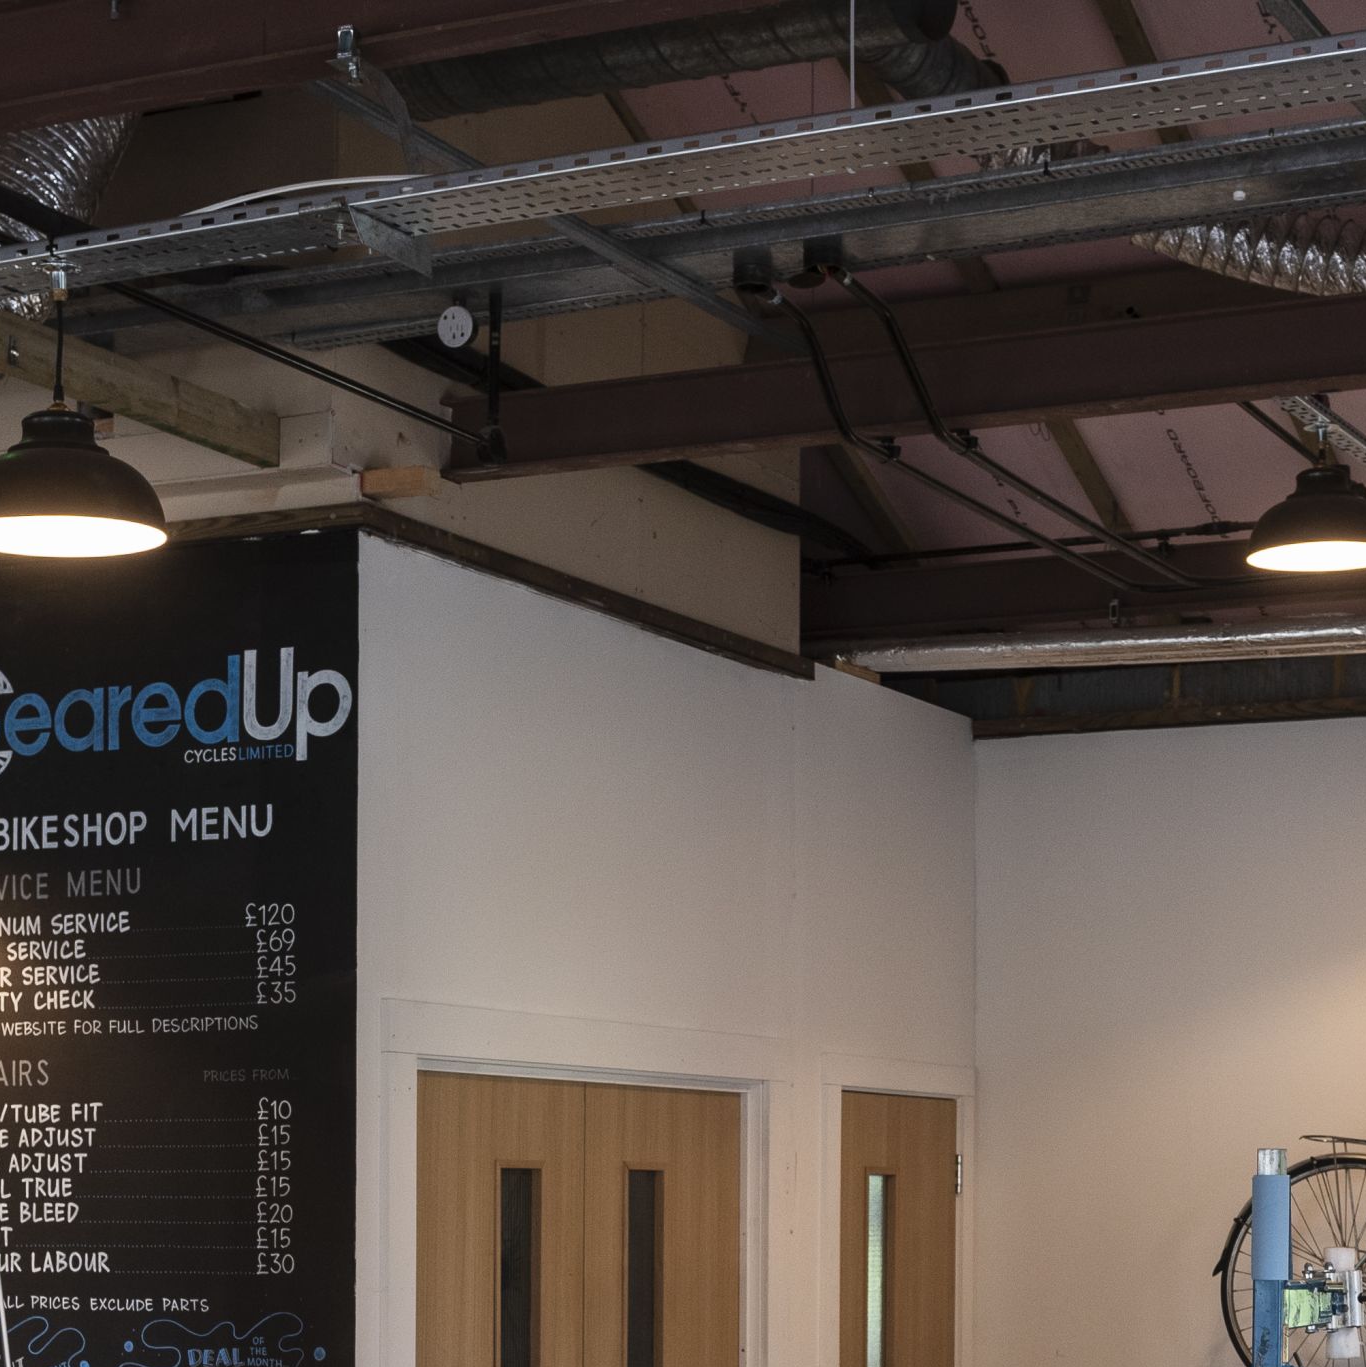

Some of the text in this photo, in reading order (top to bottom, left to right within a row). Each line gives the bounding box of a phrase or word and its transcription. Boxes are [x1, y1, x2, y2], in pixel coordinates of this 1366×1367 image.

[184, 743, 295, 764] CYCLES LIMITED
[171, 804, 274, 842] MENU
[67, 868, 141, 898] MENU
[51, 911, 131, 936] SERVICE
[245, 903, 296, 927] £120
[7, 939, 87, 961] SERVICE
[257, 928, 296, 953] £69
[22, 964, 101, 987] SERVICE
[257, 955, 296, 979] £45
[34, 989, 95, 1011] CHECK
[257, 981, 297, 1004] £35
[1, 1020, 66, 1037] WEBSITE
[74, 1019, 102, 1035] FOR
[109, 1019, 145, 1034] FULL
[152, 1015, 259, 1033] DESCRIPTIONS
[203, 1069, 246, 1083] PRICES
[71, 1102, 103, 1122] FIT
[257, 1097, 292, 1120] £10
[19, 1127, 96, 1148] ADJUST
[258, 1123, 291, 1146] £15
[9, 1152, 88, 1173] ADJUST
[257, 1150, 291, 1171] £15
[22, 1178, 73, 1199] TRUE
[256, 1175, 290, 1197] £15
[20, 1202, 79, 1224] BLEED
[257, 1201, 293, 1224] £20
[257, 1226, 291, 1249] £15
[31, 1251, 111, 1273] LABOUR
[257, 1252, 295, 1275] £30
[31, 1296, 81, 1310] PRICES
[90, 1297, 154, 1312] EXCLUDE
[163, 1298, 210, 1312] PARTS
[250, 1346, 267, 1356] THE
[252, 1336, 266, 1345] OF
